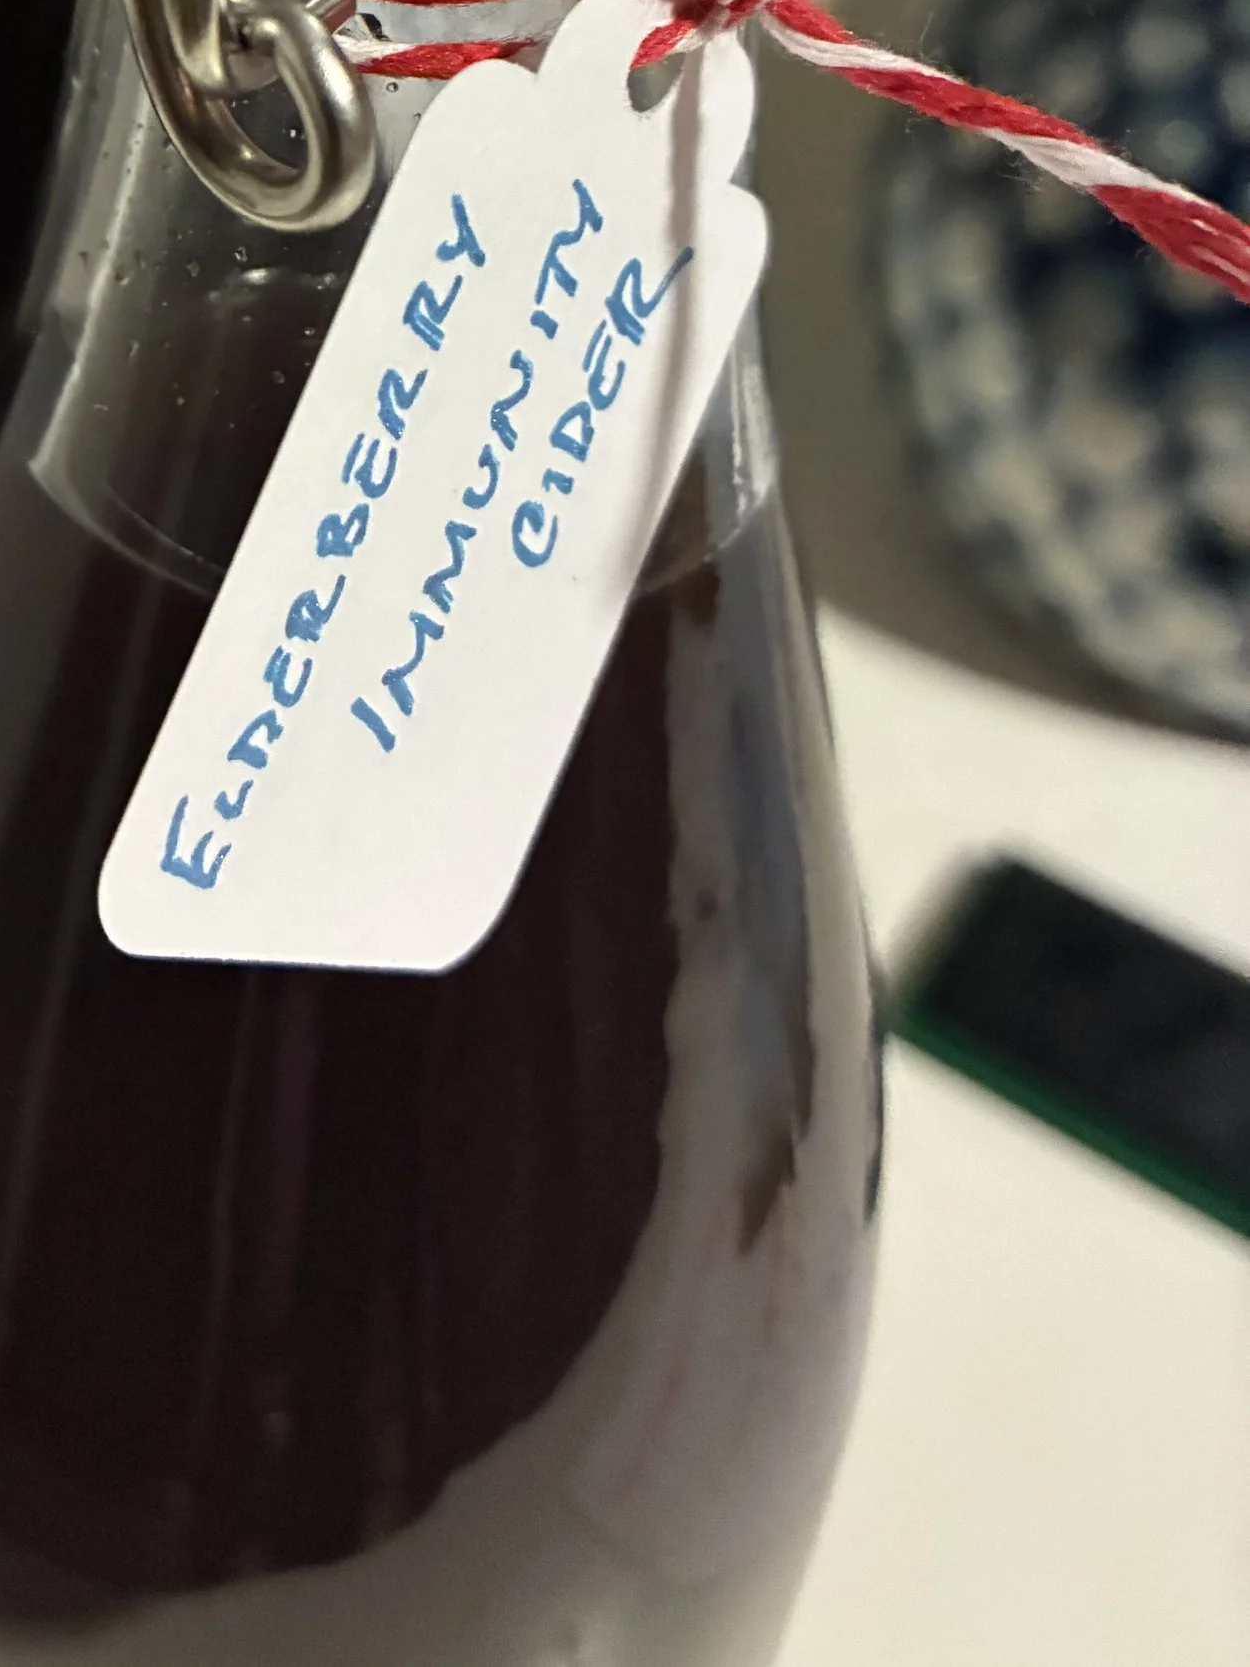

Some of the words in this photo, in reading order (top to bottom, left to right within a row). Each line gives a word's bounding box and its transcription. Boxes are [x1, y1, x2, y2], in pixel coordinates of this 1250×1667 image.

[161, 193, 487, 889] ELDERBERRY
[350, 178, 605, 751] IMMUNITY
[510, 245, 695, 569] CIDER
